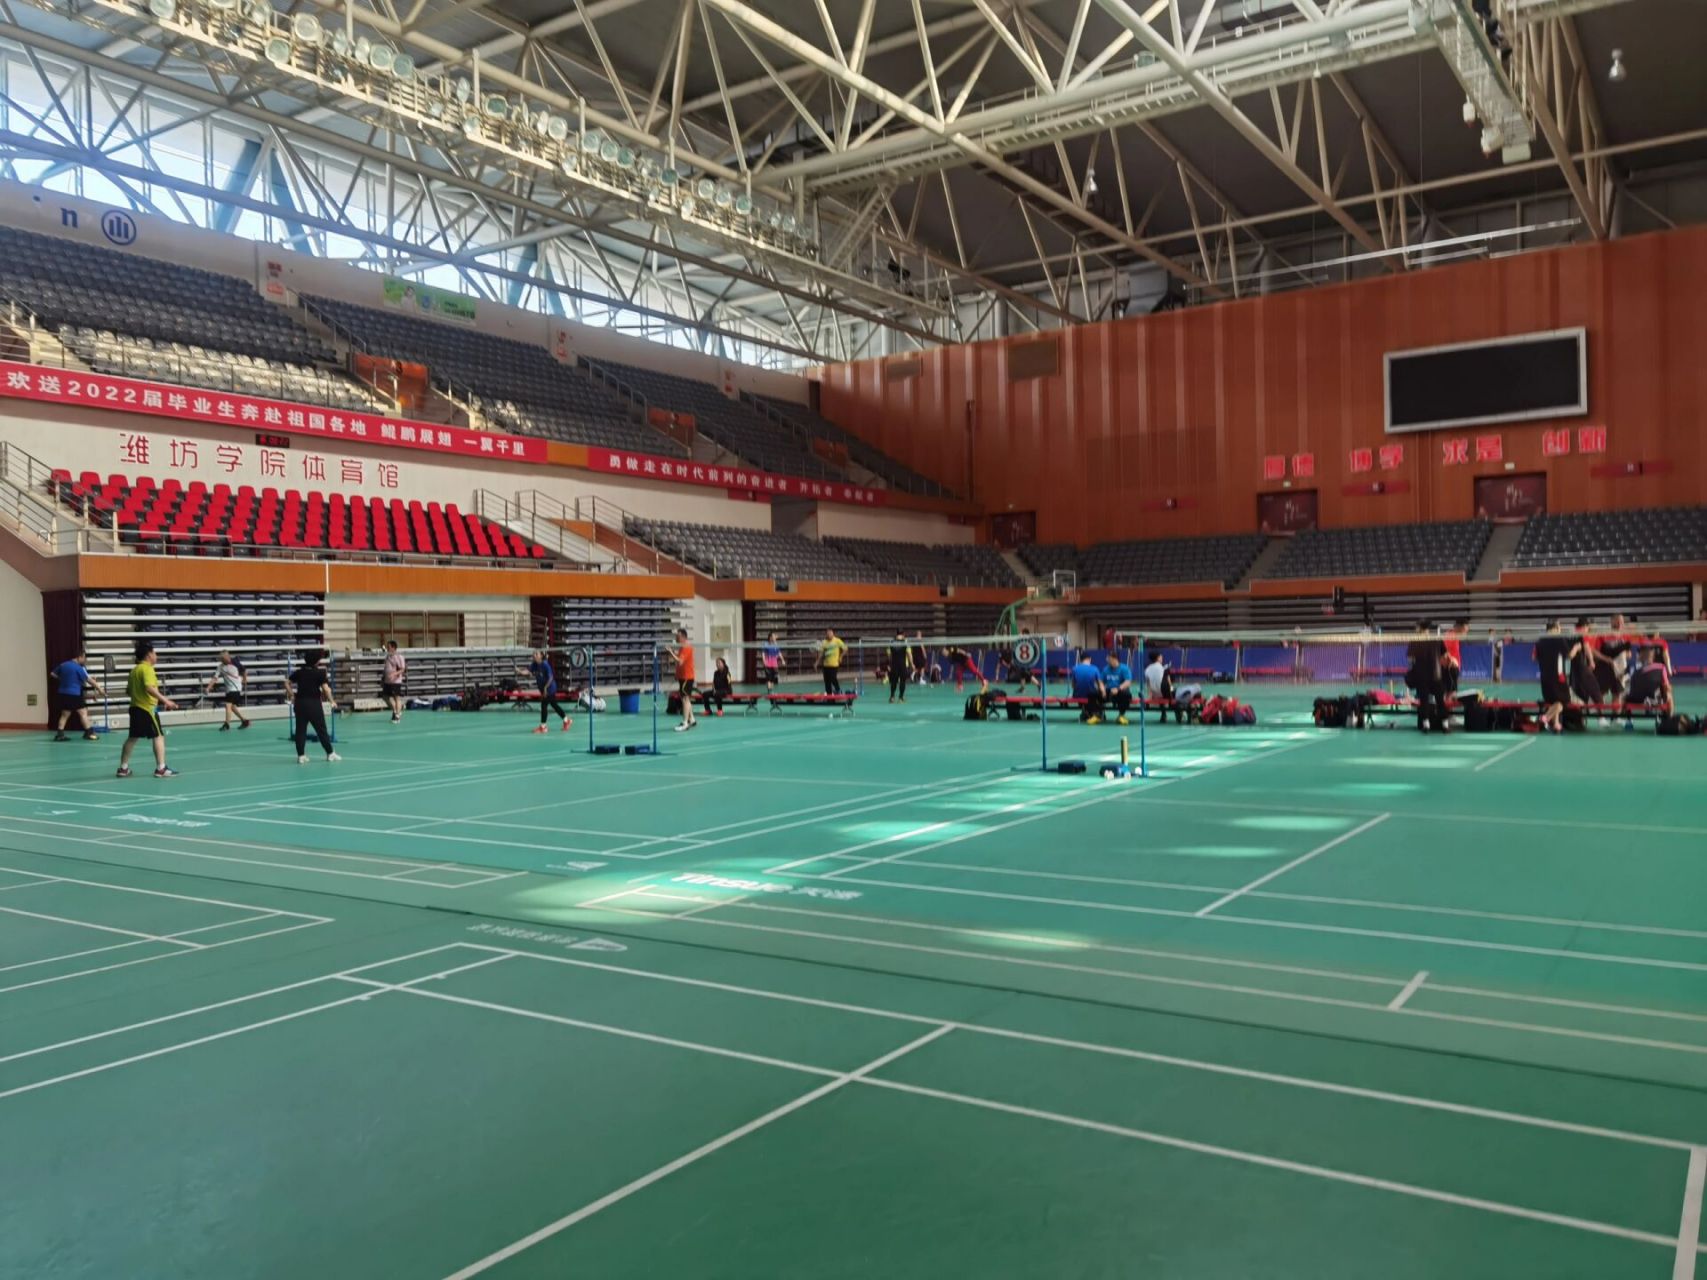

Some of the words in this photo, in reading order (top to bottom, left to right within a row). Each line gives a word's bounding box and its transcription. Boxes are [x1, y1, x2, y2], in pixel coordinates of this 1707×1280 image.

[7, 371, 367, 436] 欢送2022届毕业生奔赴祖国各地
[381, 423, 452, 447] 鲲鹏展翅
[119, 433, 398, 488] 潍坊学院体育馆
[1019, 644, 1030, 660] 8
